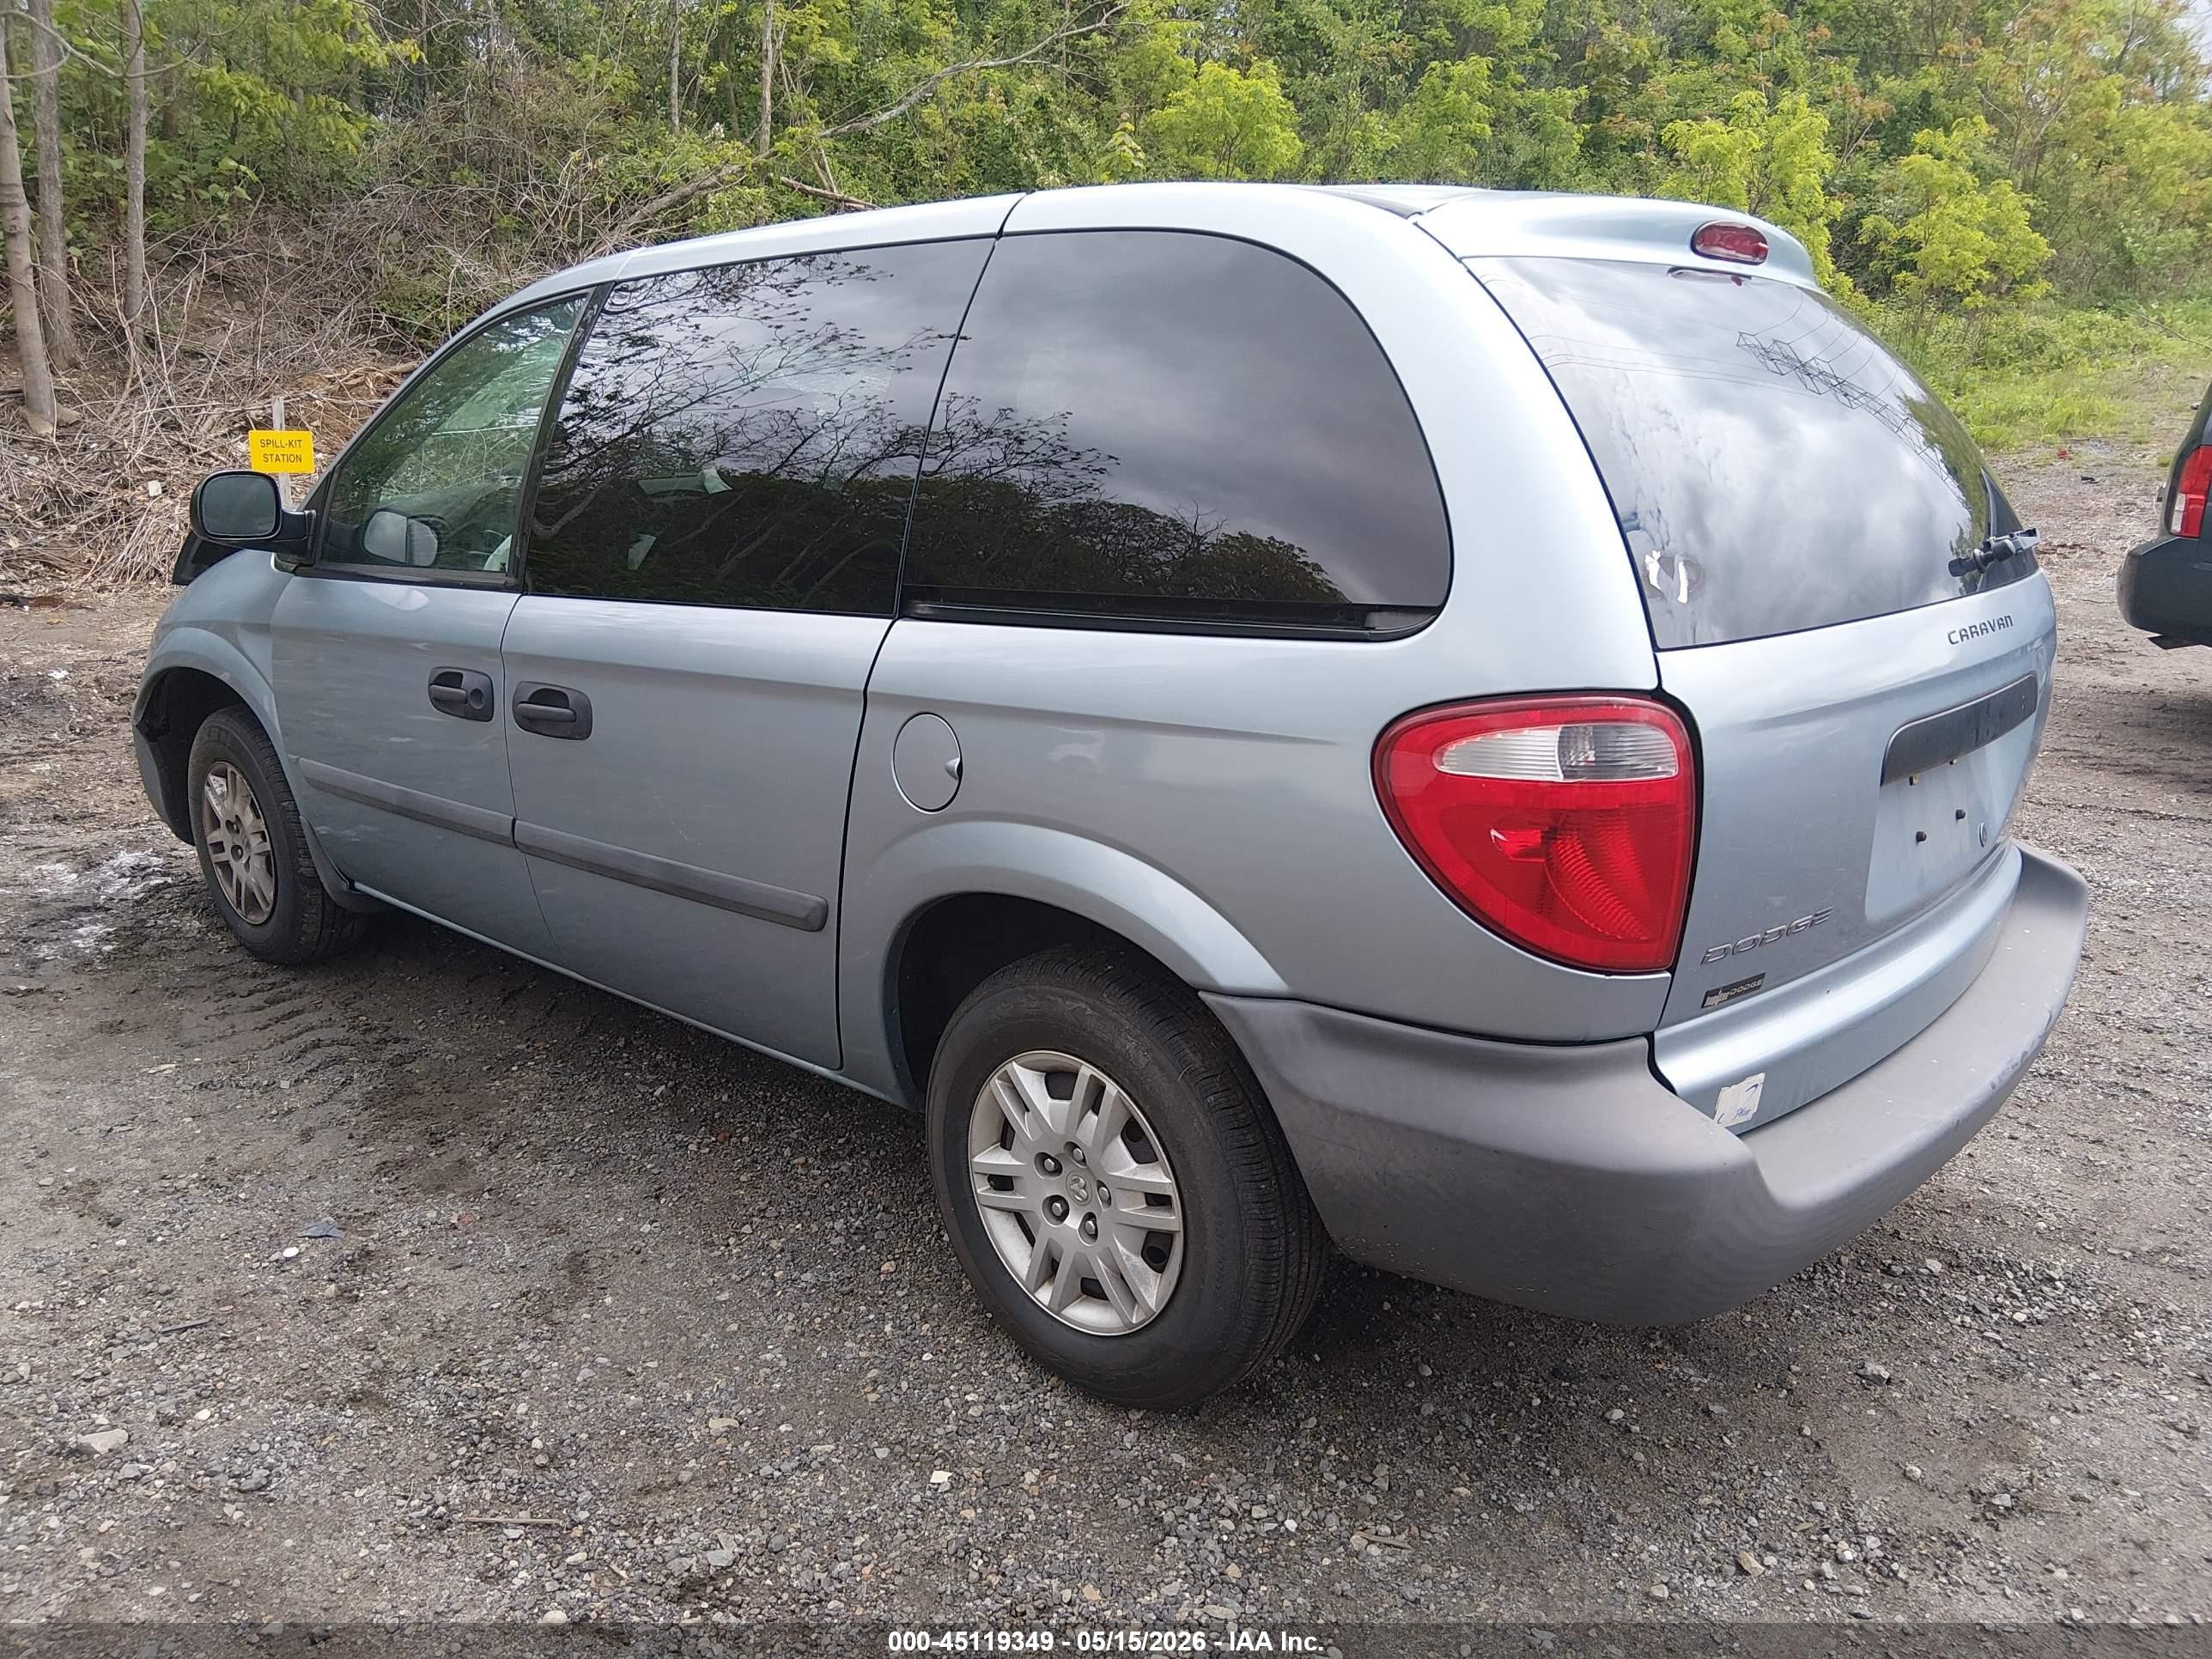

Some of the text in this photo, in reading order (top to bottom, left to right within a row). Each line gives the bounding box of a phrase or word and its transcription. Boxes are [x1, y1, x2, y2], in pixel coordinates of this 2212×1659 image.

[259, 439, 303, 448] SPILL-KIT
[263, 453, 302, 463] STATION
[1948, 615, 2014, 645] CARAVAN
[1700, 906, 1834, 966] DODGE
[1729, 979, 1763, 995] DODGE
